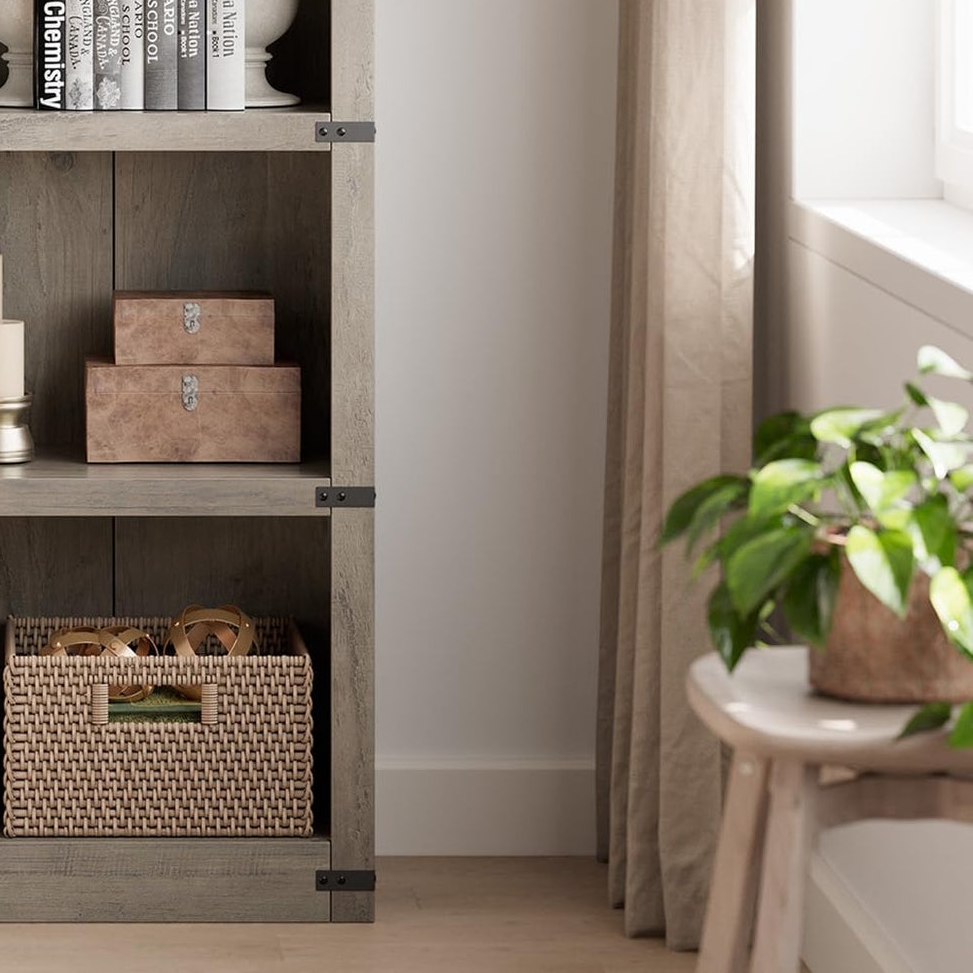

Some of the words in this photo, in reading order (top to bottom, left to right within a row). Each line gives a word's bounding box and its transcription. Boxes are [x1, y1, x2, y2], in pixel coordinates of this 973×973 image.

[188, 0, 198, 8] a
[223, 0, 234, 8] a
[40, 1, 65, 109] Chemistry
[122, 4, 130, 65] SCHOOL
[147, 0, 158, 64] SCHOOL
[188, 11, 200, 57] Nation
[223, 11, 238, 57] Nation
